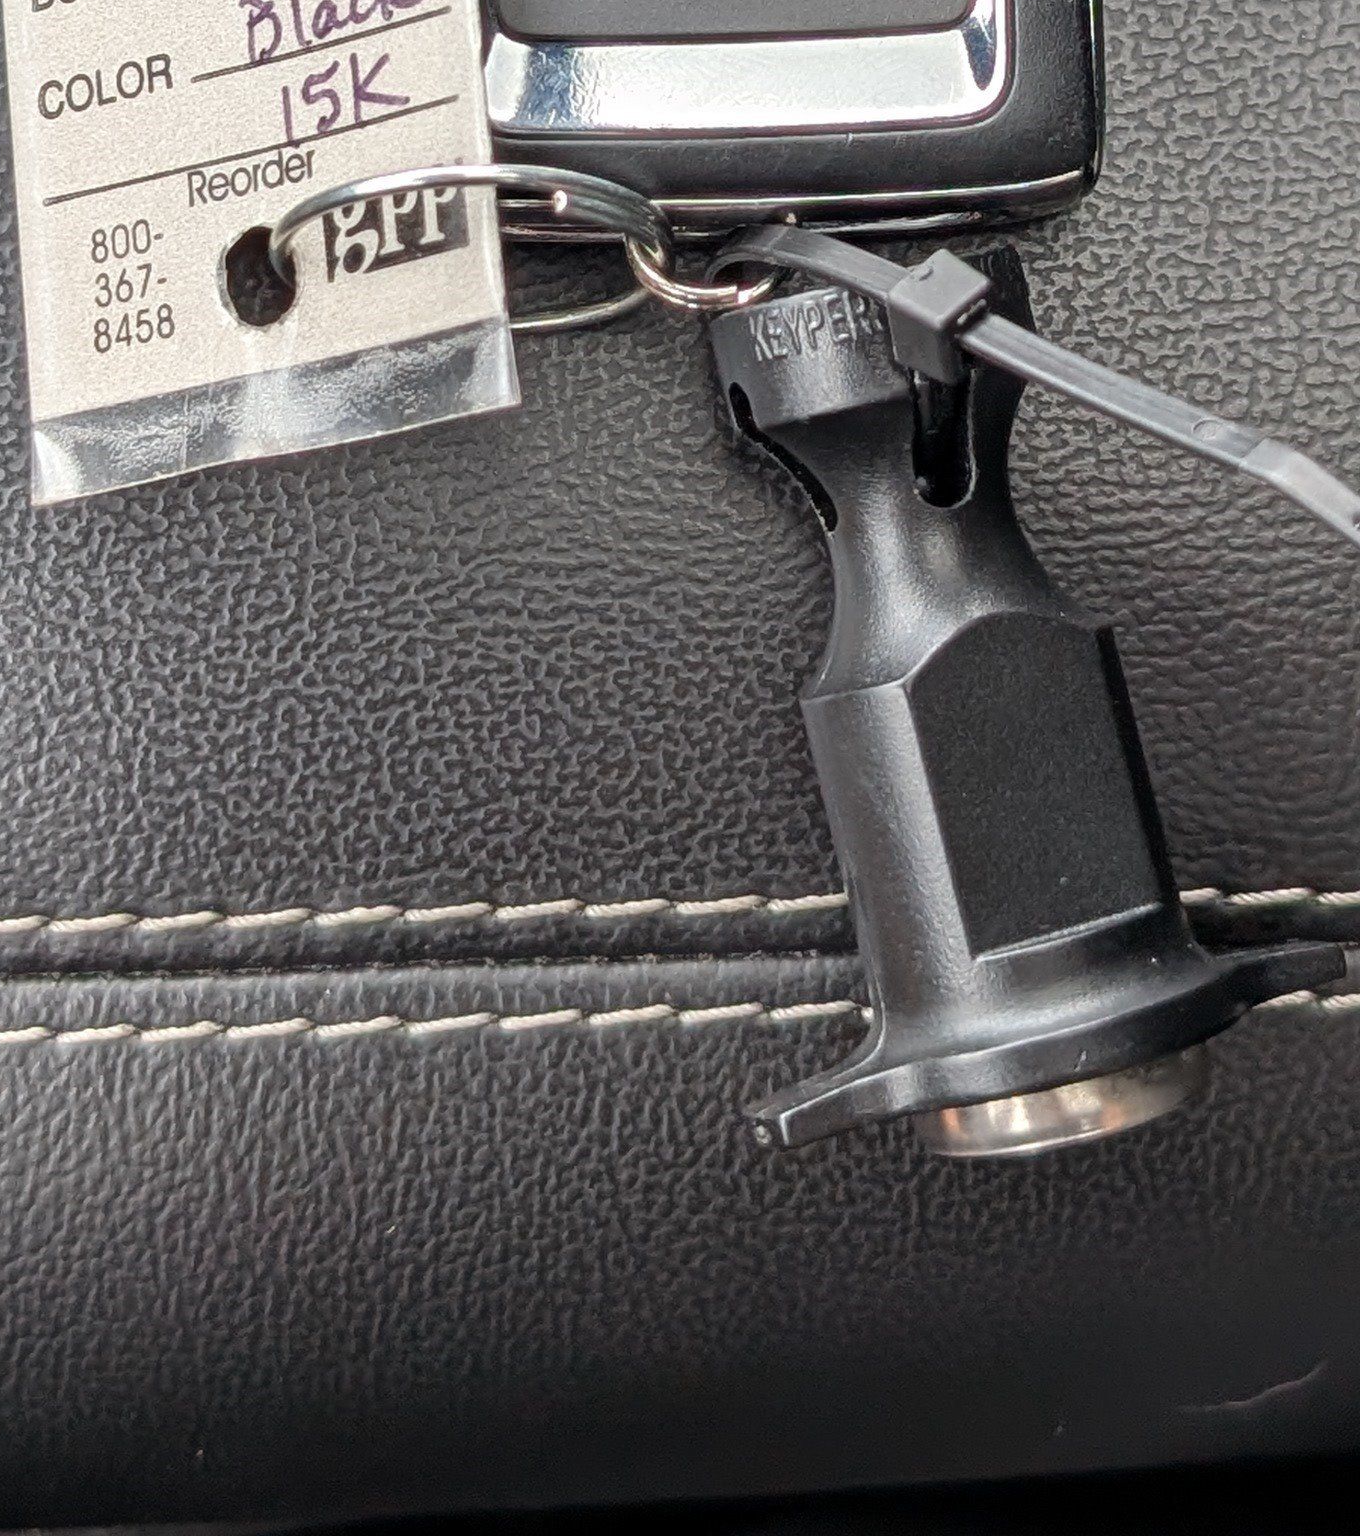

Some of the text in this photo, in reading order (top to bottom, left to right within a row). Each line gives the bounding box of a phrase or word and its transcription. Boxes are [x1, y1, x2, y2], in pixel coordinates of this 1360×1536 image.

[38, 53, 175, 120] COLOR
[281, 52, 410, 146] 15K
[187, 147, 316, 207] Reorder
[90, 218, 164, 264] 800-
[94, 264, 168, 308] 367-
[93, 303, 176, 354] 8458
